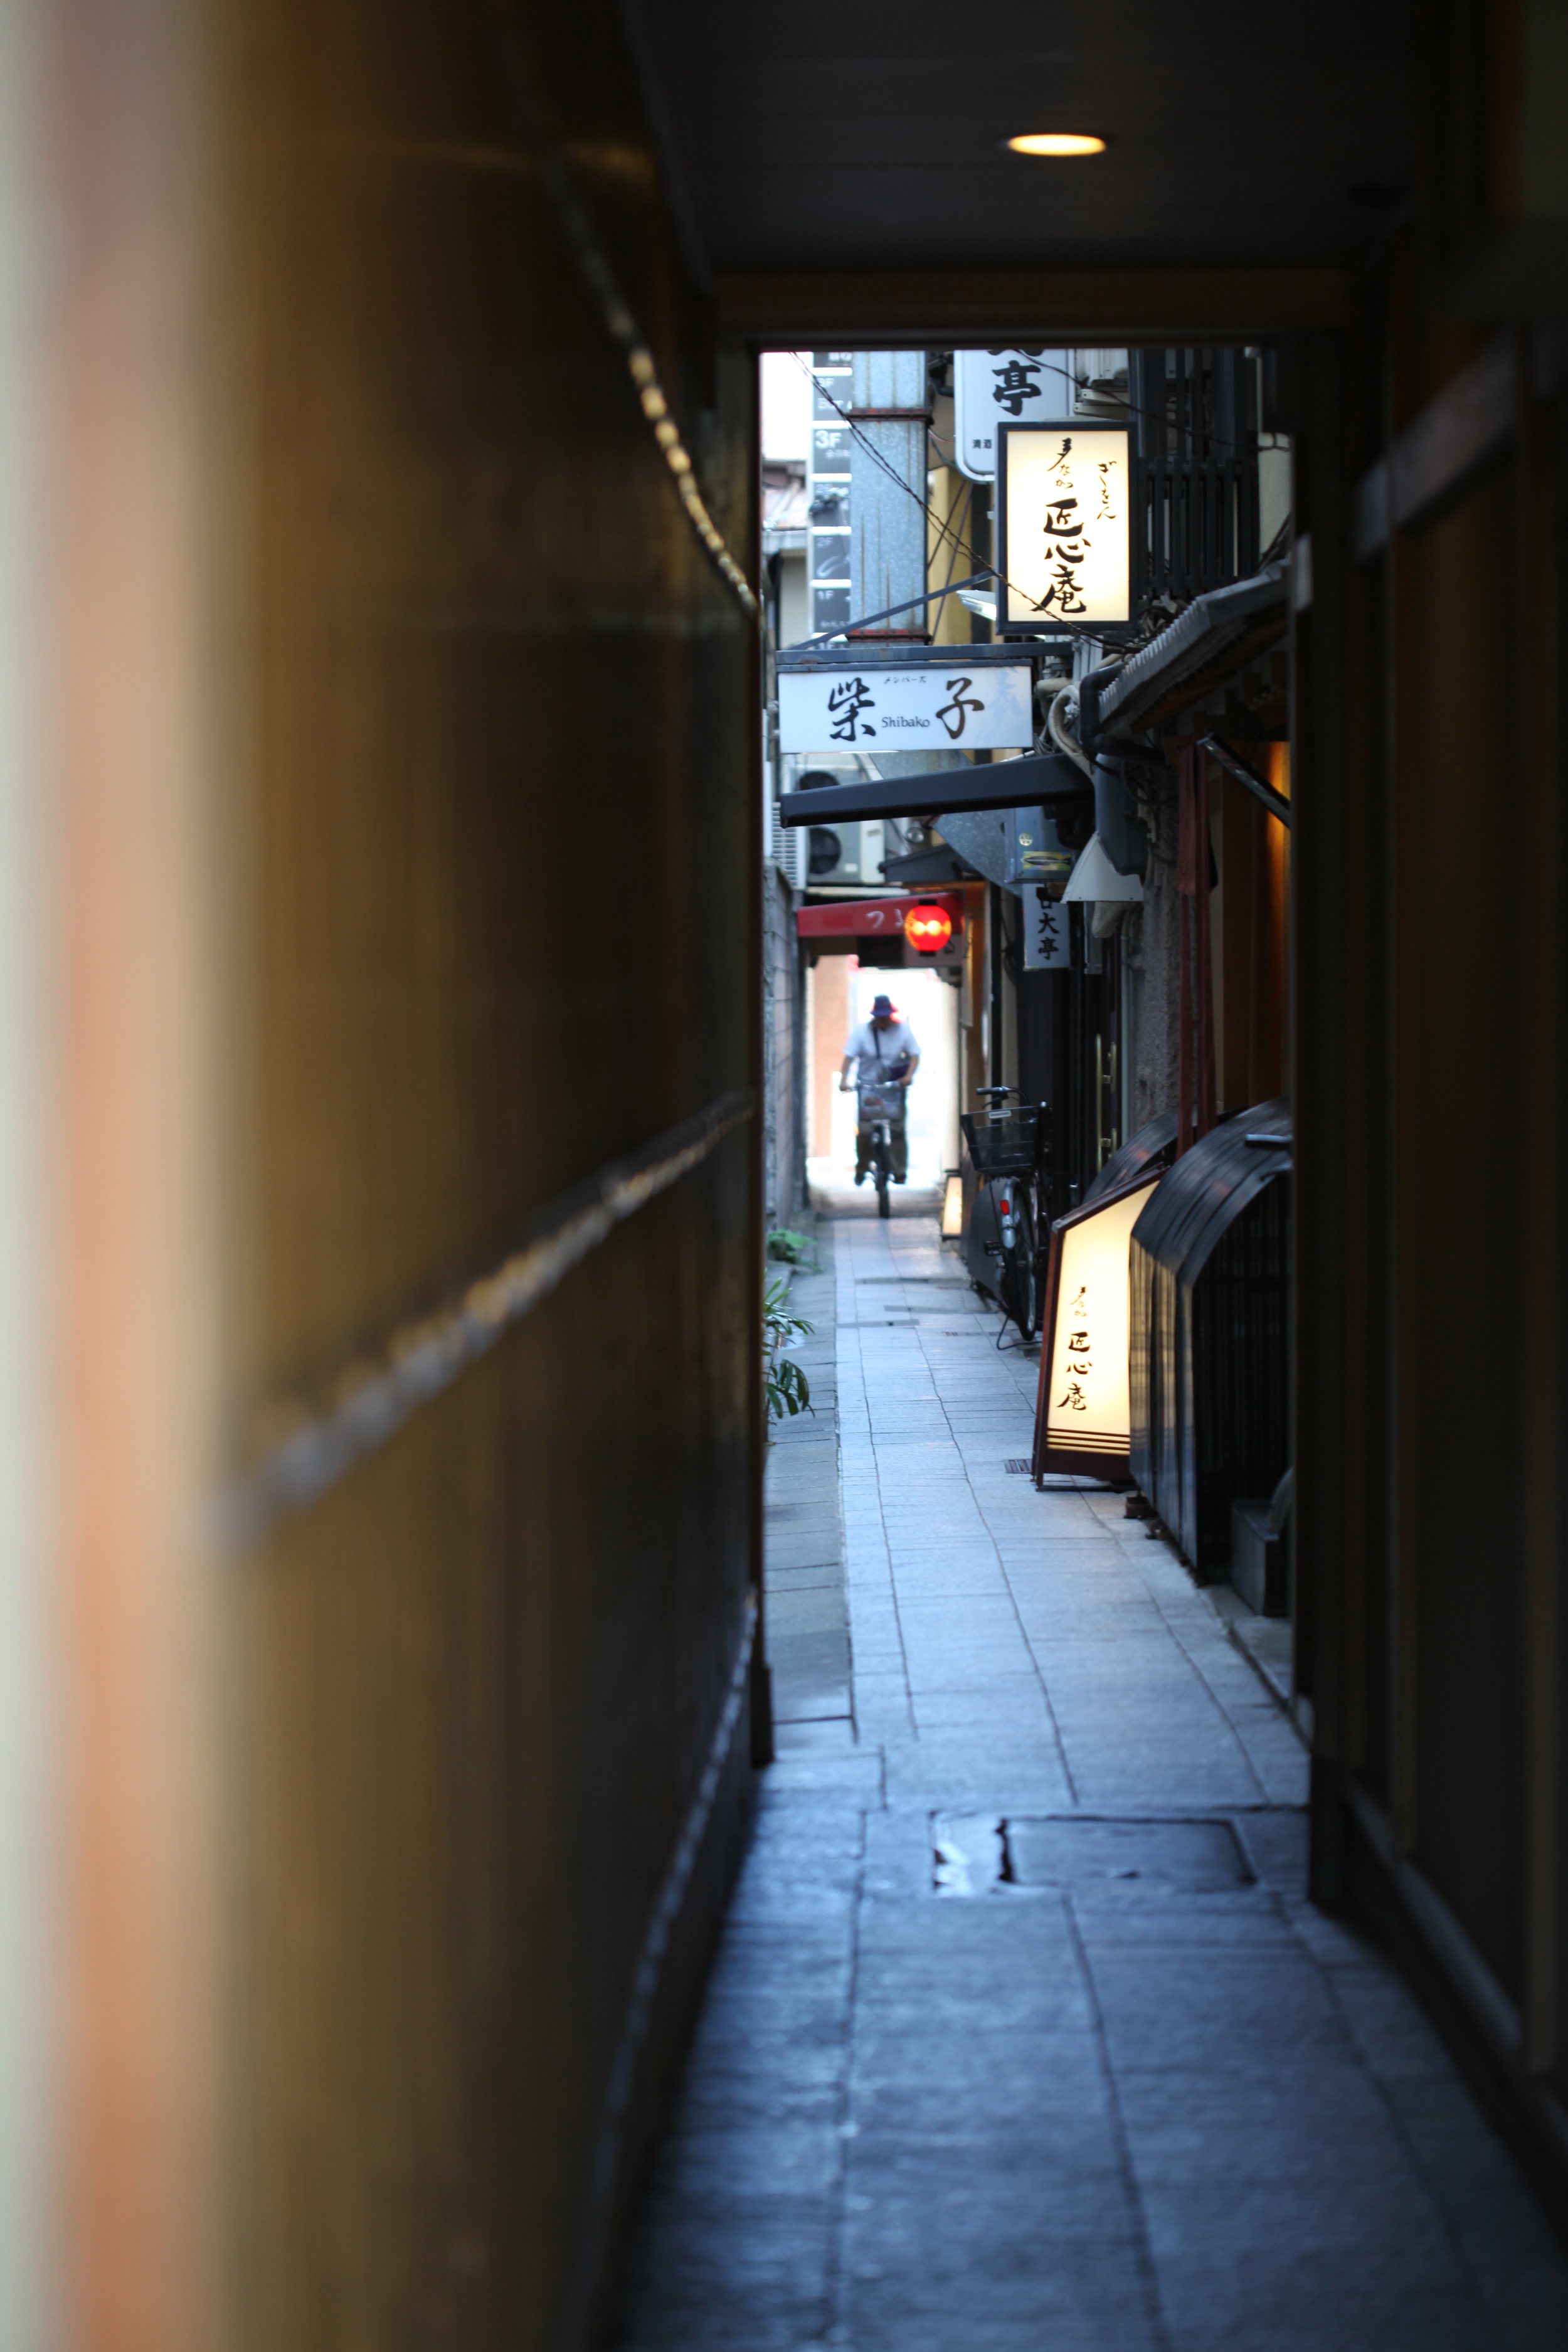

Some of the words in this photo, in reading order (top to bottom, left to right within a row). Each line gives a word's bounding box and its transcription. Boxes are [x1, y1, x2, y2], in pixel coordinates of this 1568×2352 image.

[987, 349, 1044, 416] 亭
[815, 430, 842, 448] 3F
[817, 538, 833, 547] 2F
[1030, 498, 1091, 613] 匠心庵
[818, 590, 834, 600] 1F
[881, 716, 930, 728] Shibako
[936, 677, 985, 739] 子
[1057, 1332, 1093, 1411] 匠心庵
